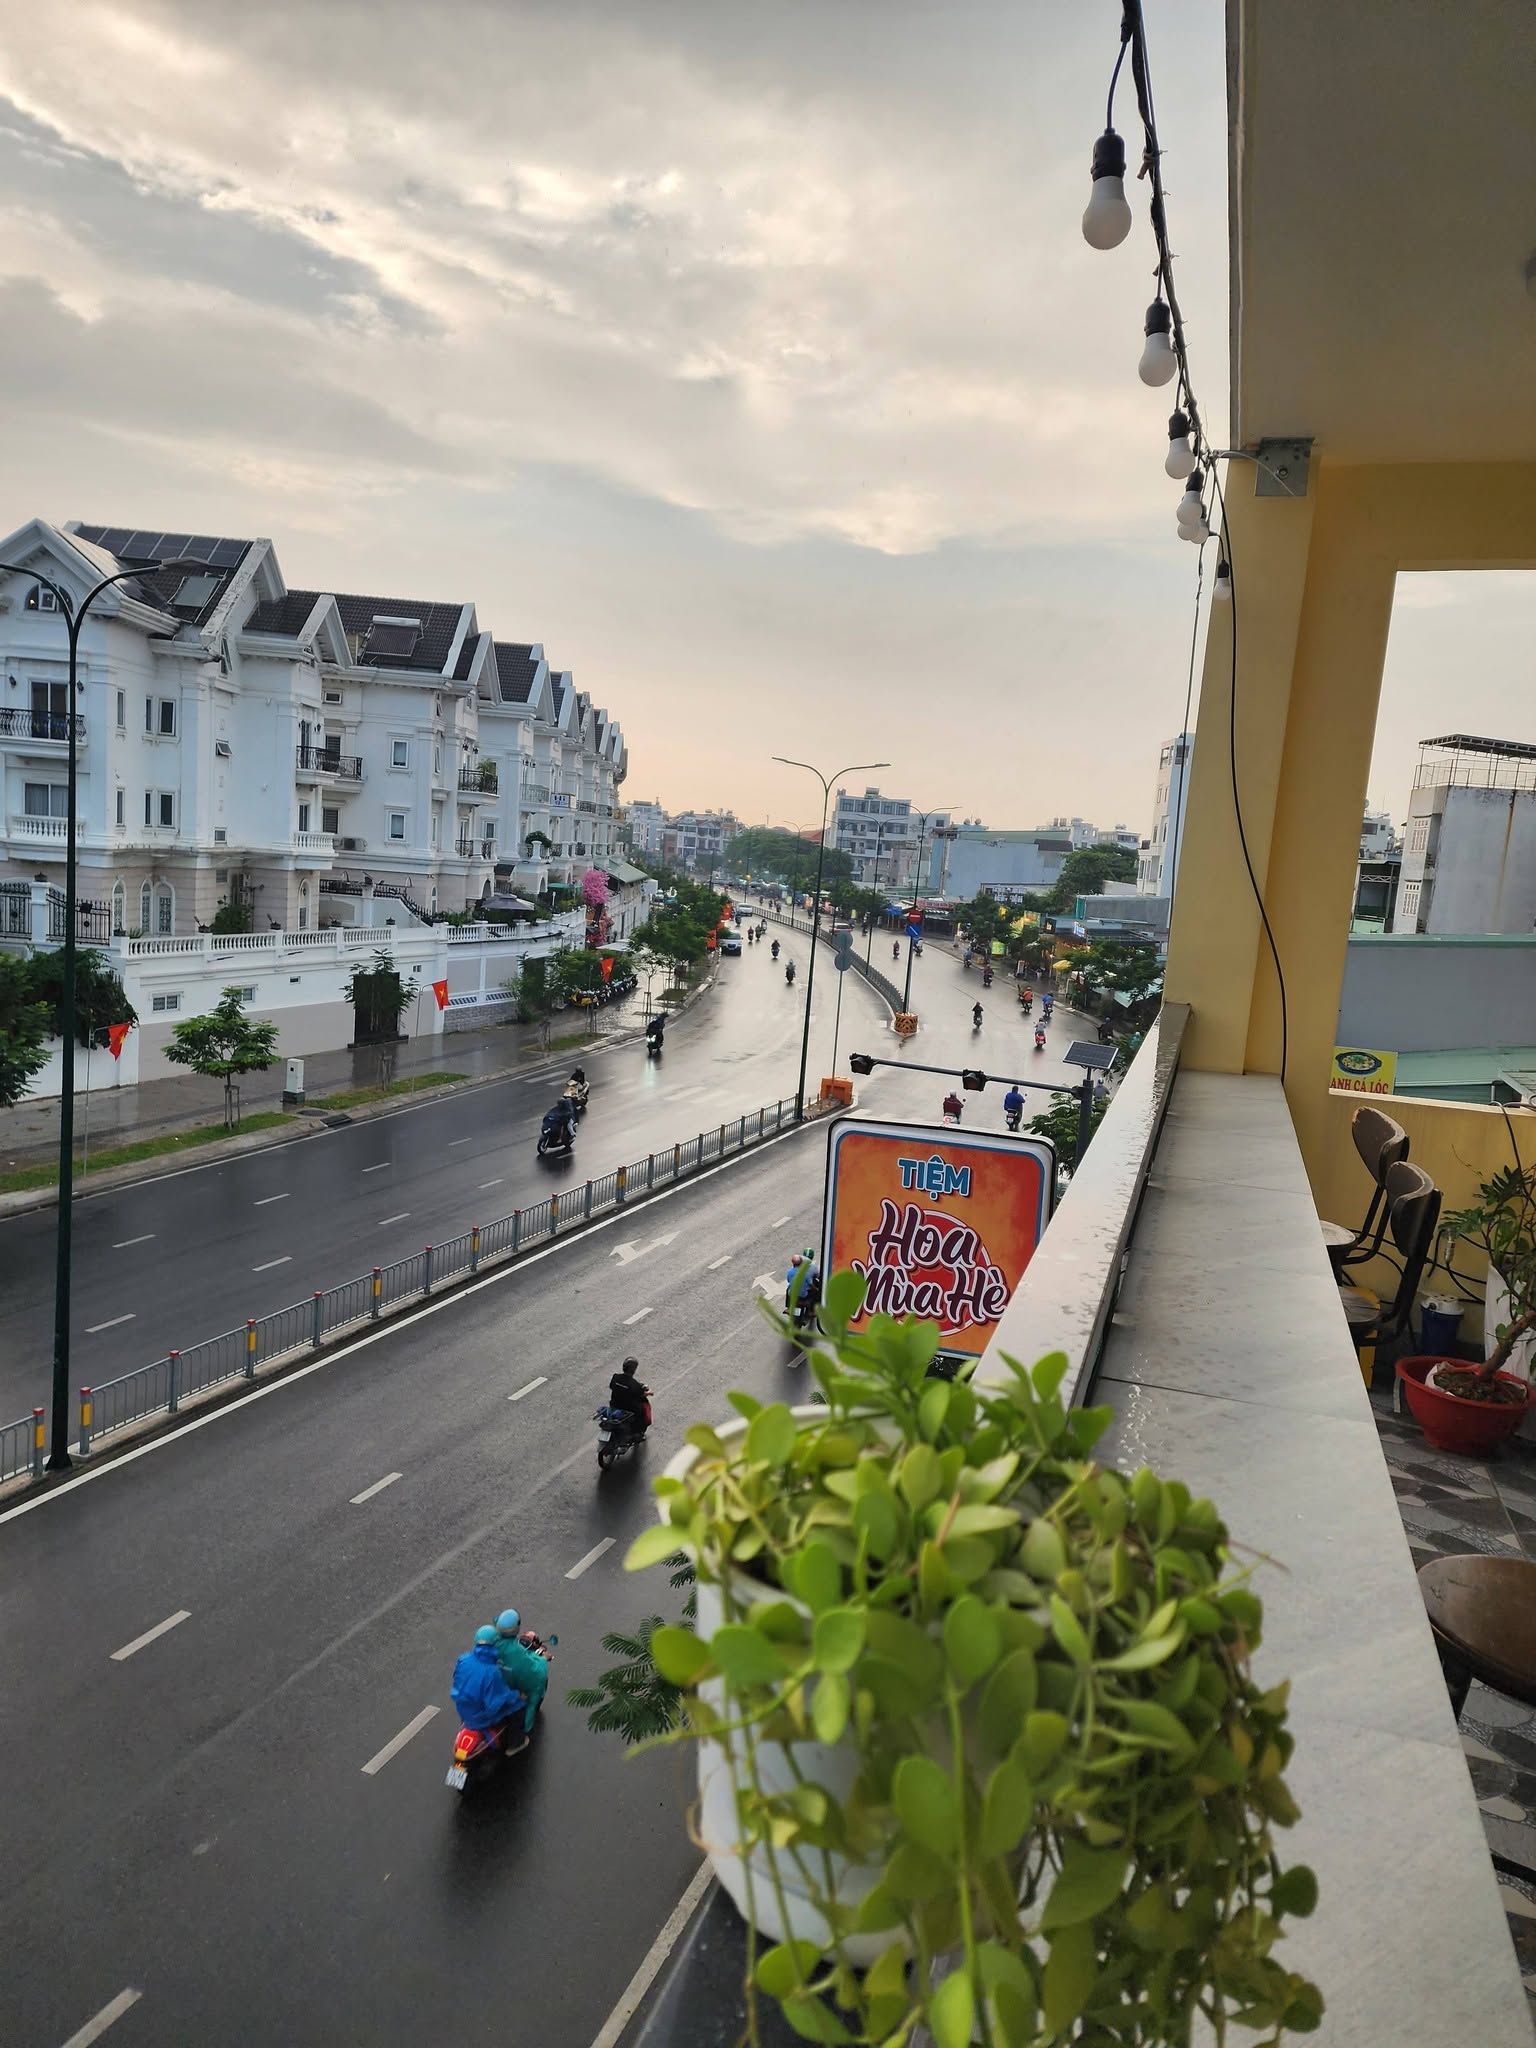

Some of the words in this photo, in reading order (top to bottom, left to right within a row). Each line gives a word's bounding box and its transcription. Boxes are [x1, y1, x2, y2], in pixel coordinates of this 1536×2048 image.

[898, 1155, 971, 1200] TIỆM
[868, 1199, 981, 1271] Hoa
[851, 1259, 944, 1321] Mùa
[944, 1264, 1009, 1325] Hè
